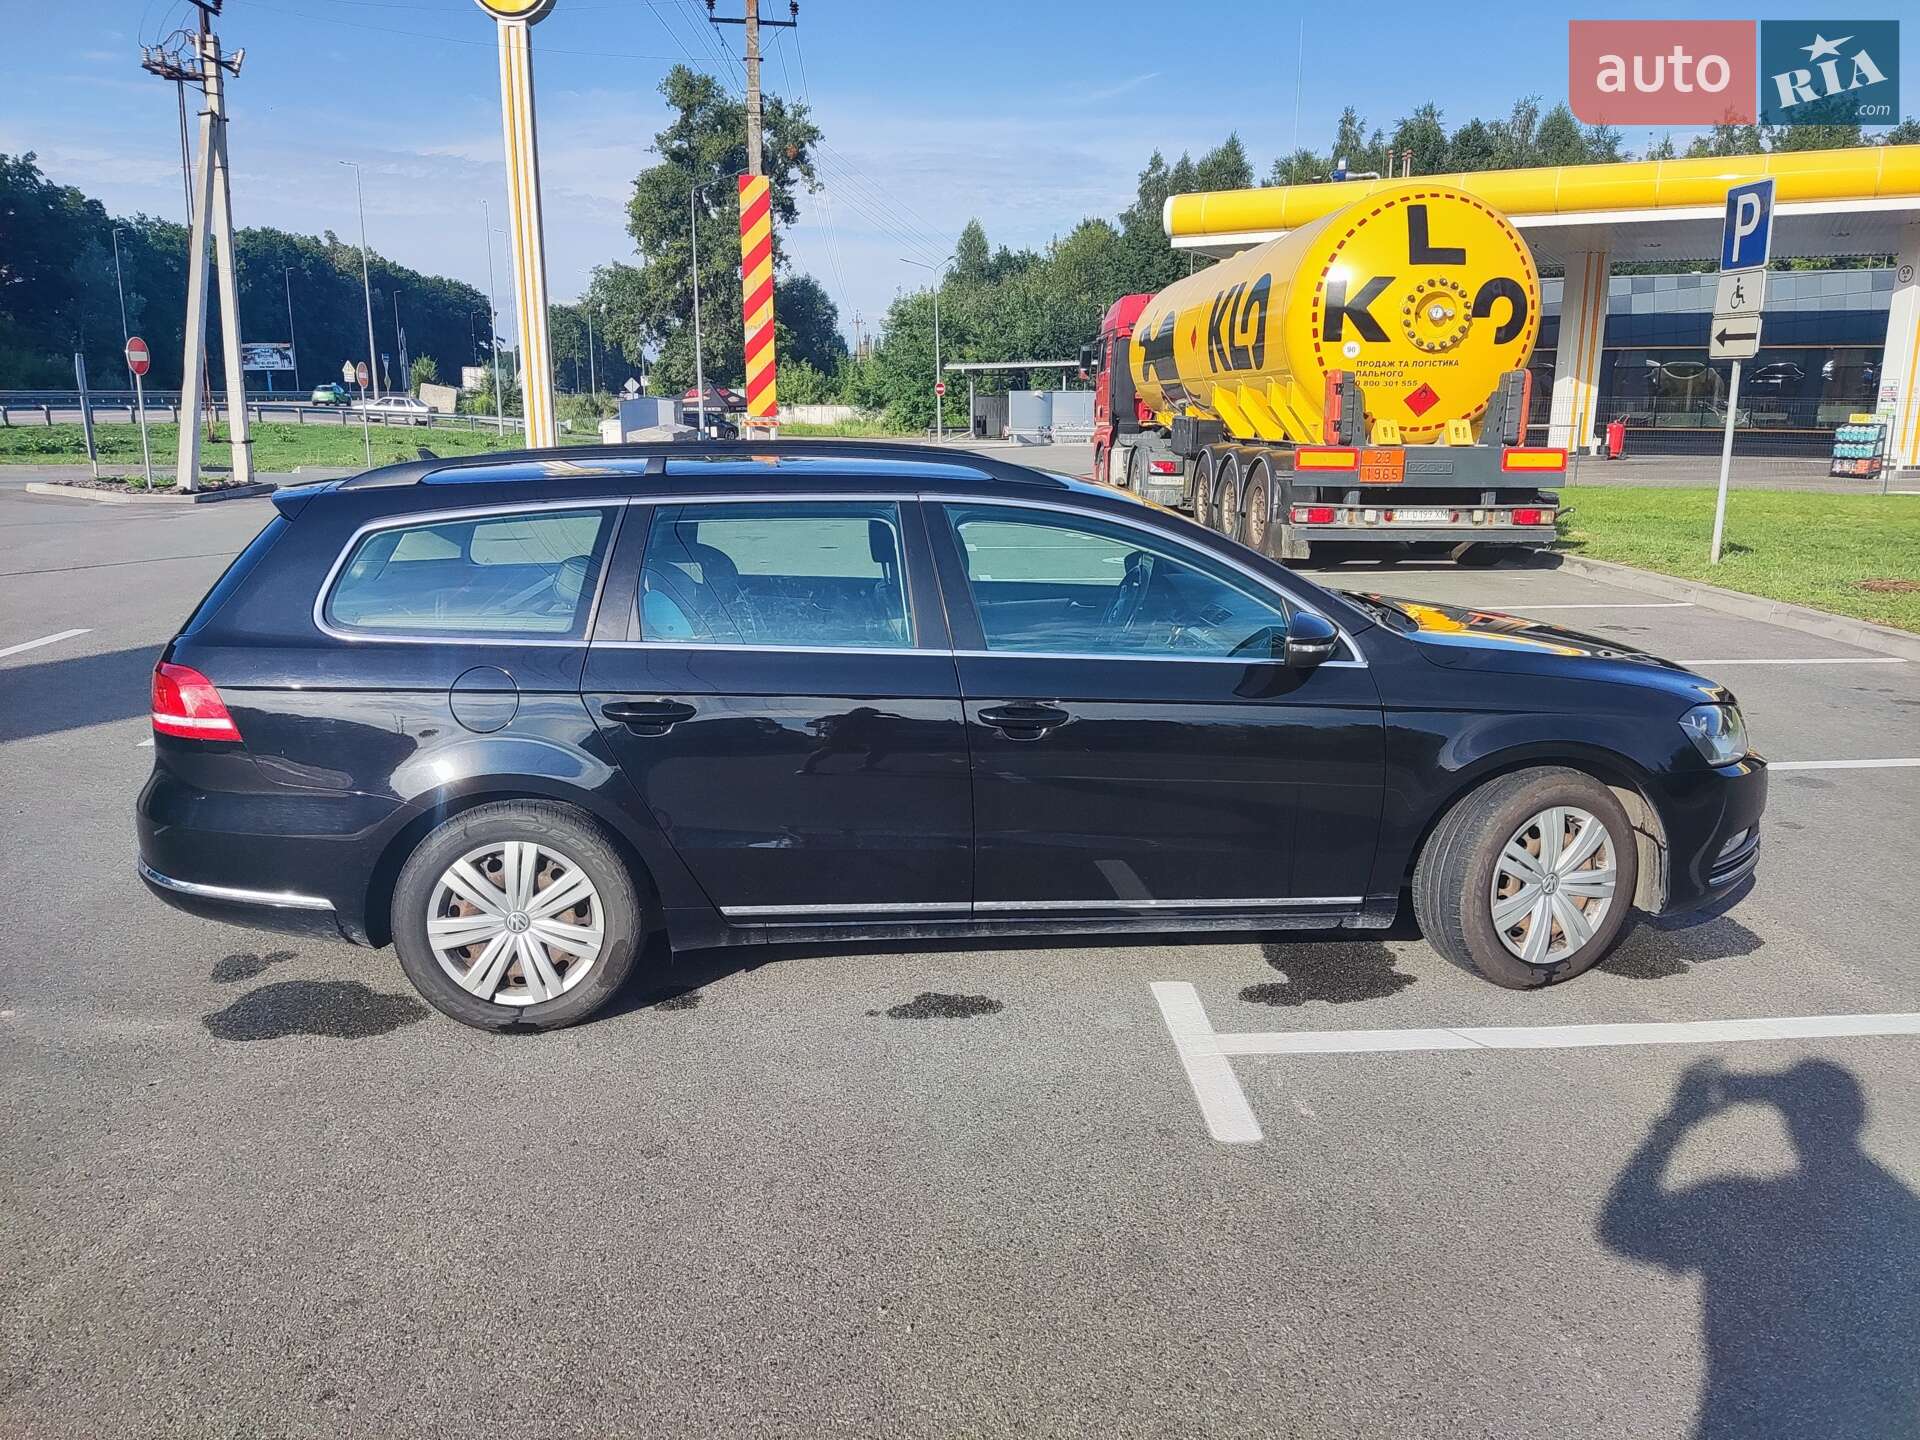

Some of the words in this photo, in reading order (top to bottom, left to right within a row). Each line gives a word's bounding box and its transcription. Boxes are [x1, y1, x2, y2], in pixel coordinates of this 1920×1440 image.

[1732, 192, 1761, 263] P
[1356, 360, 1396, 368] ПРОДАЖ
[1399, 360, 1409, 368] ТА
[1411, 359, 1460, 368] ЛОГІСТИКА
[1355, 370, 1404, 378] ПАЛЬНОГО
[1376, 452, 1392, 465] 23
[1366, 468, 1398, 480] 1965
